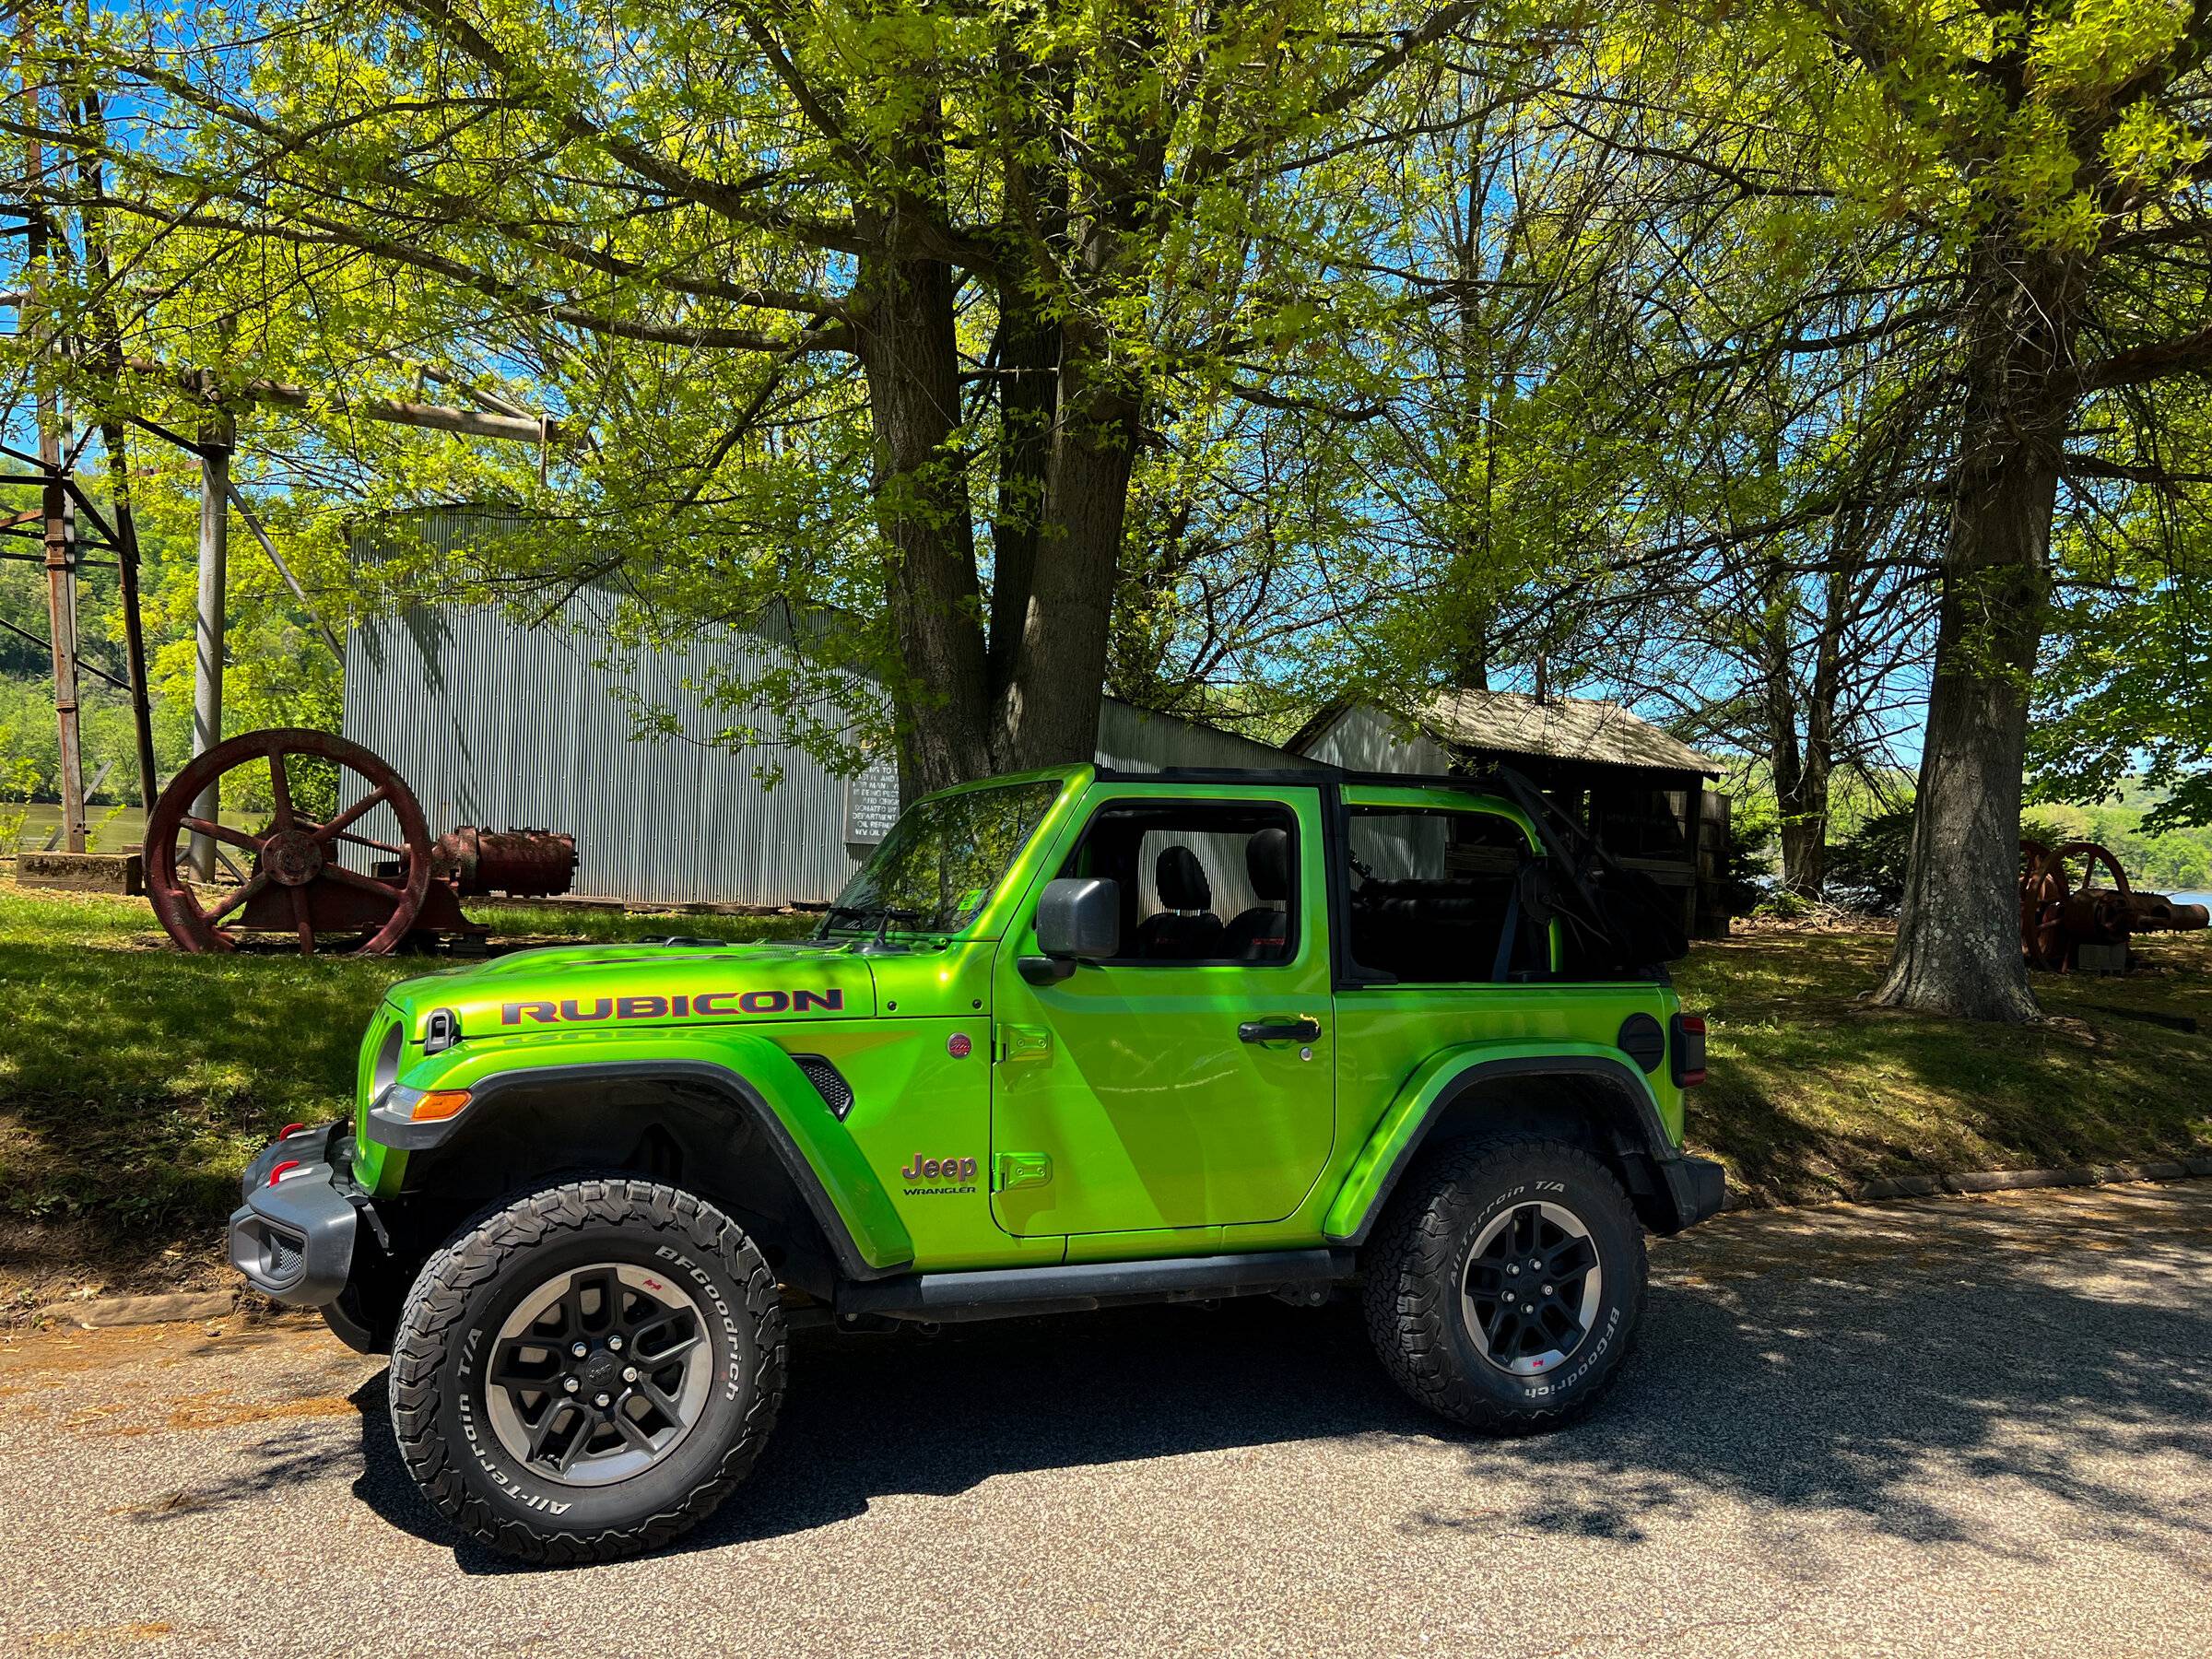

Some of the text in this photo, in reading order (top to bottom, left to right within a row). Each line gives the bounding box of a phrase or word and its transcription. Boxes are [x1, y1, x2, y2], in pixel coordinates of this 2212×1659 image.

[853, 812, 897, 821] DEPARTMENT
[500, 988, 843, 1026] RUBICON
[901, 1152, 977, 1182] Jeep
[903, 1186, 976, 1195] WRANGLER
[654, 1246, 740, 1401] BFGoodrich
[1524, 1306, 1620, 1398] BFGoodrich
